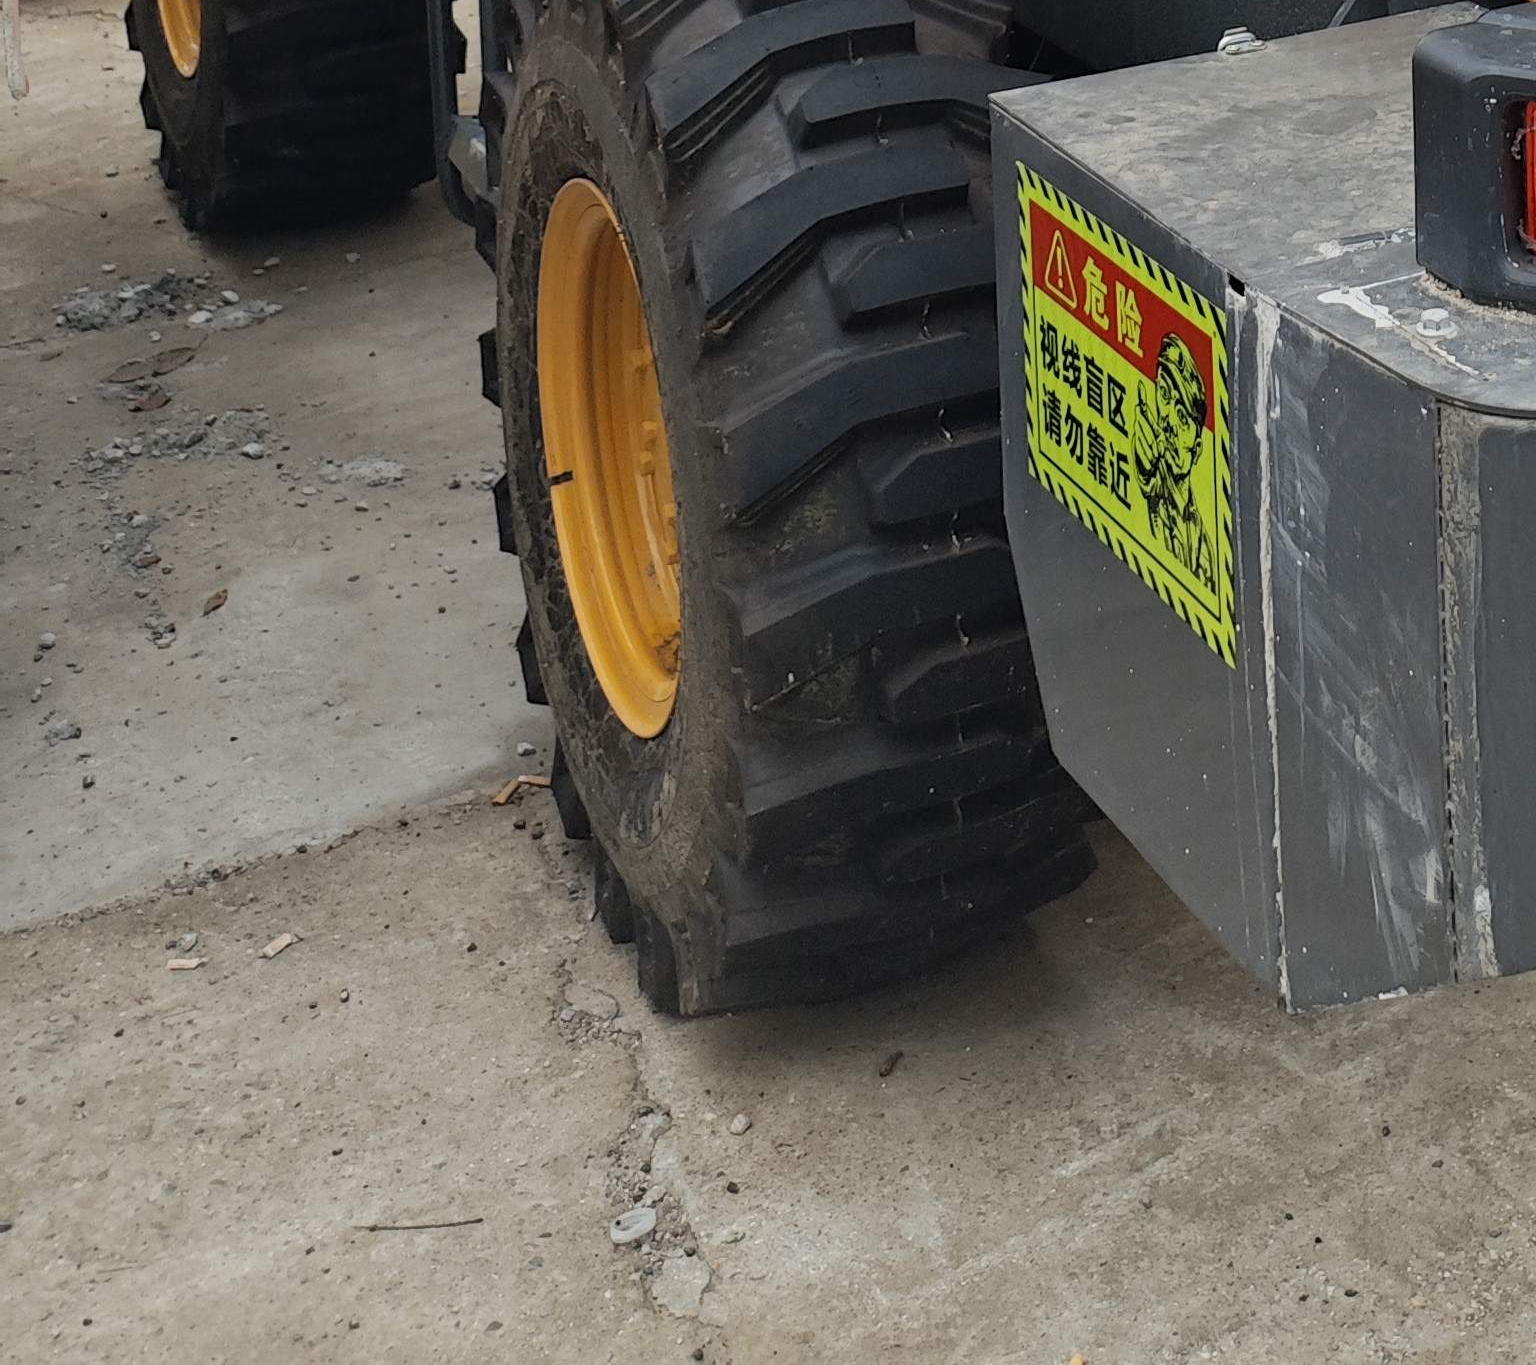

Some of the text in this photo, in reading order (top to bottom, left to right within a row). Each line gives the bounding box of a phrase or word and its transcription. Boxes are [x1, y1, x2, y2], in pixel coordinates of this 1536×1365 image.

[1081, 255, 1144, 359] 危险
[1038, 313, 1130, 439] 视线盲区
[1041, 393, 1132, 512] 请勿靠近
